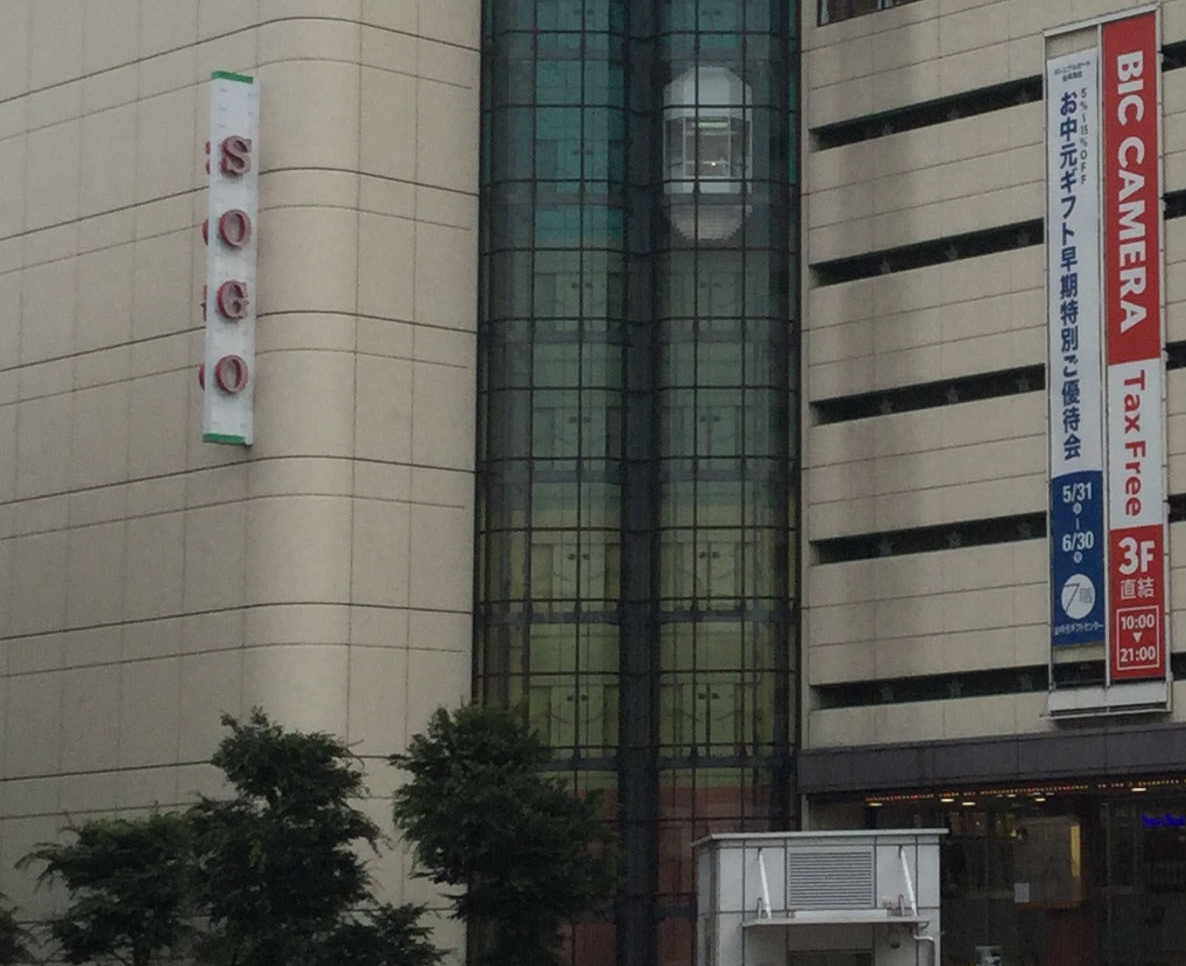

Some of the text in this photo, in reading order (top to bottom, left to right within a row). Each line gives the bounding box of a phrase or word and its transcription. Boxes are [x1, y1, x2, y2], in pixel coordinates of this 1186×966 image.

[1116, 50, 1147, 334] BIC CAMERA
[216, 135, 252, 394] SOGO
[1123, 369, 1147, 517] Tax Free
[1062, 482, 1092, 503] 5/31
[1062, 531, 1094, 552] 6/30
[1118, 537, 1156, 574] 3F
[1120, 576, 1155, 600] 直結
[1120, 614, 1155, 630] 10:00
[1120, 645, 1156, 663] 21:00
